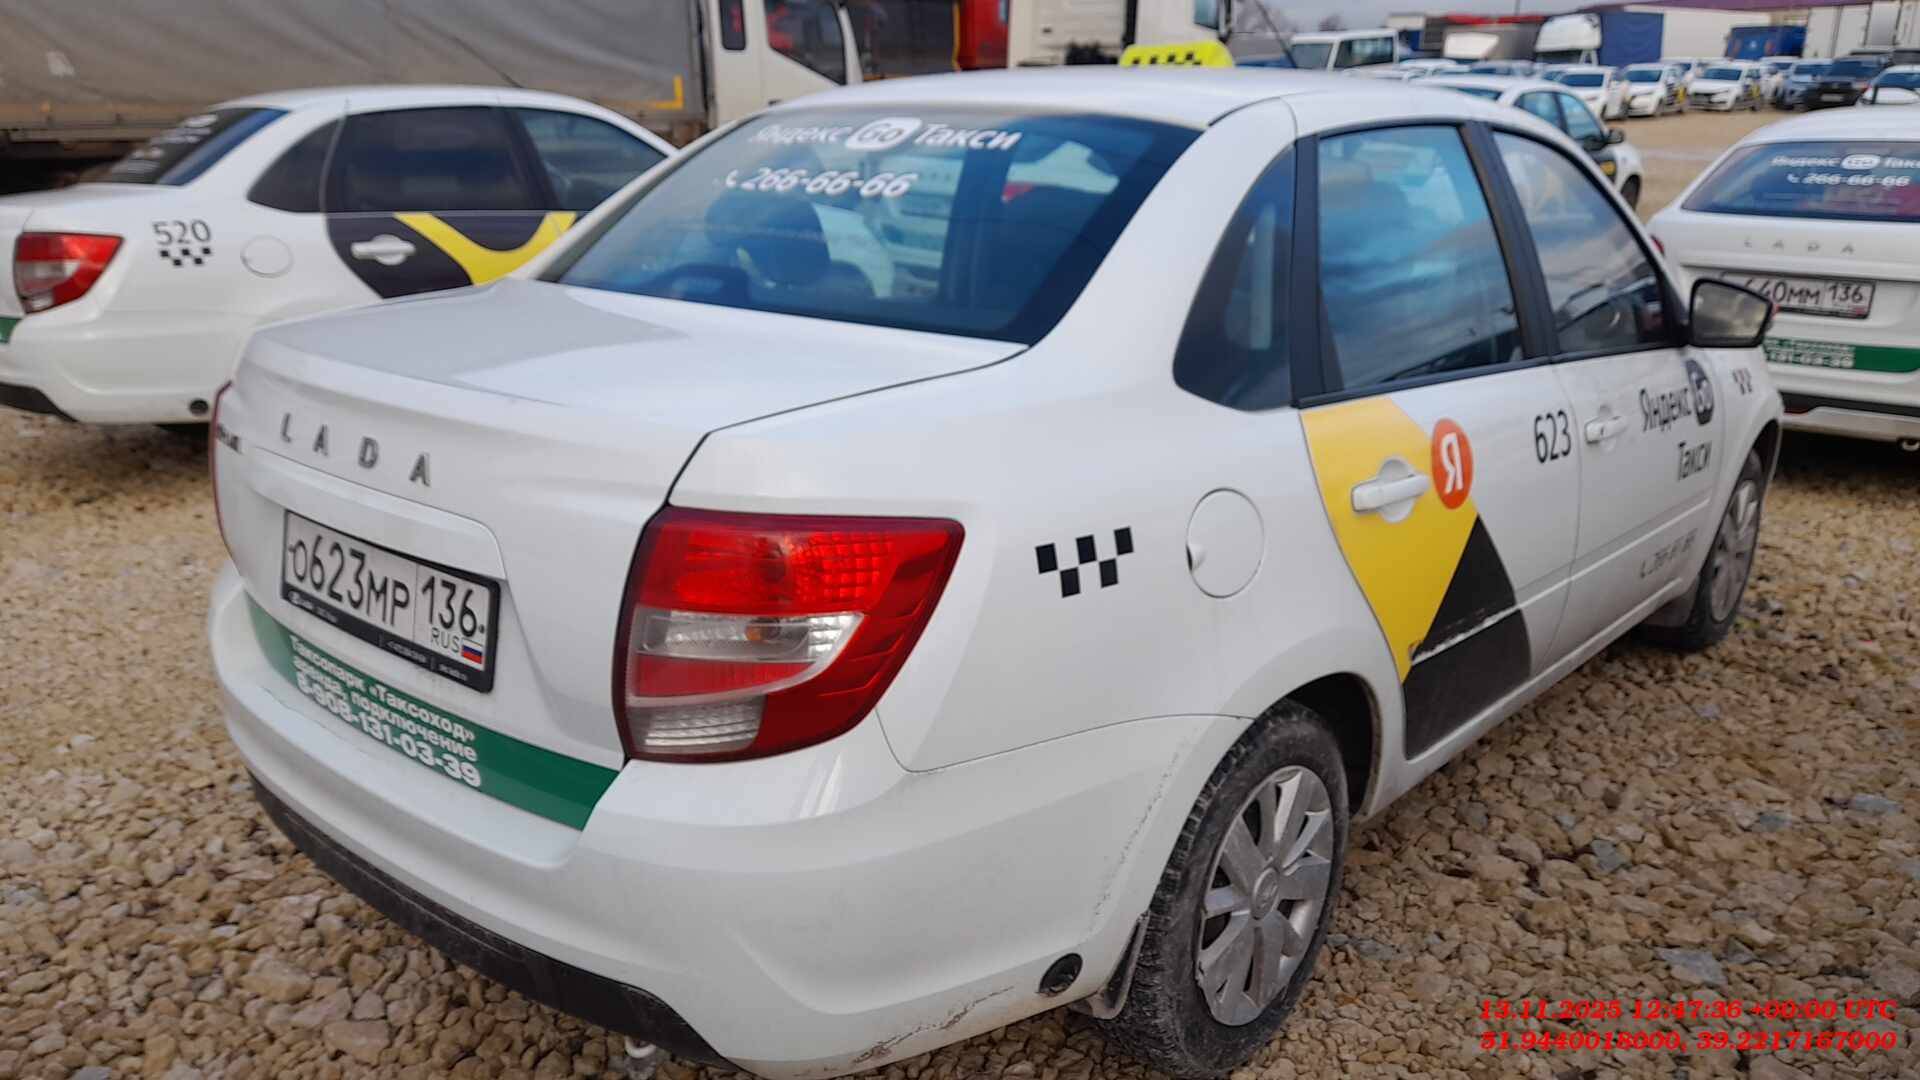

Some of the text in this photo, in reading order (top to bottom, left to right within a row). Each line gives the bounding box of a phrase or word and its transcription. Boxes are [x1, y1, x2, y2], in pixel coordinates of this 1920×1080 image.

[914, 124, 1023, 151] Такси
[742, 166, 918, 198] 266-66-66
[153, 220, 211, 246] 520
[1829, 284, 1864, 303] 136
[280, 413, 431, 487] LADA
[1440, 431, 1464, 495] Я
[1534, 410, 1572, 464] 623
[421, 574, 478, 638] 136
[430, 627, 460, 654] RUS
[351, 691, 478, 762] подключение
[369, 684, 476, 743] «Таксоход»
